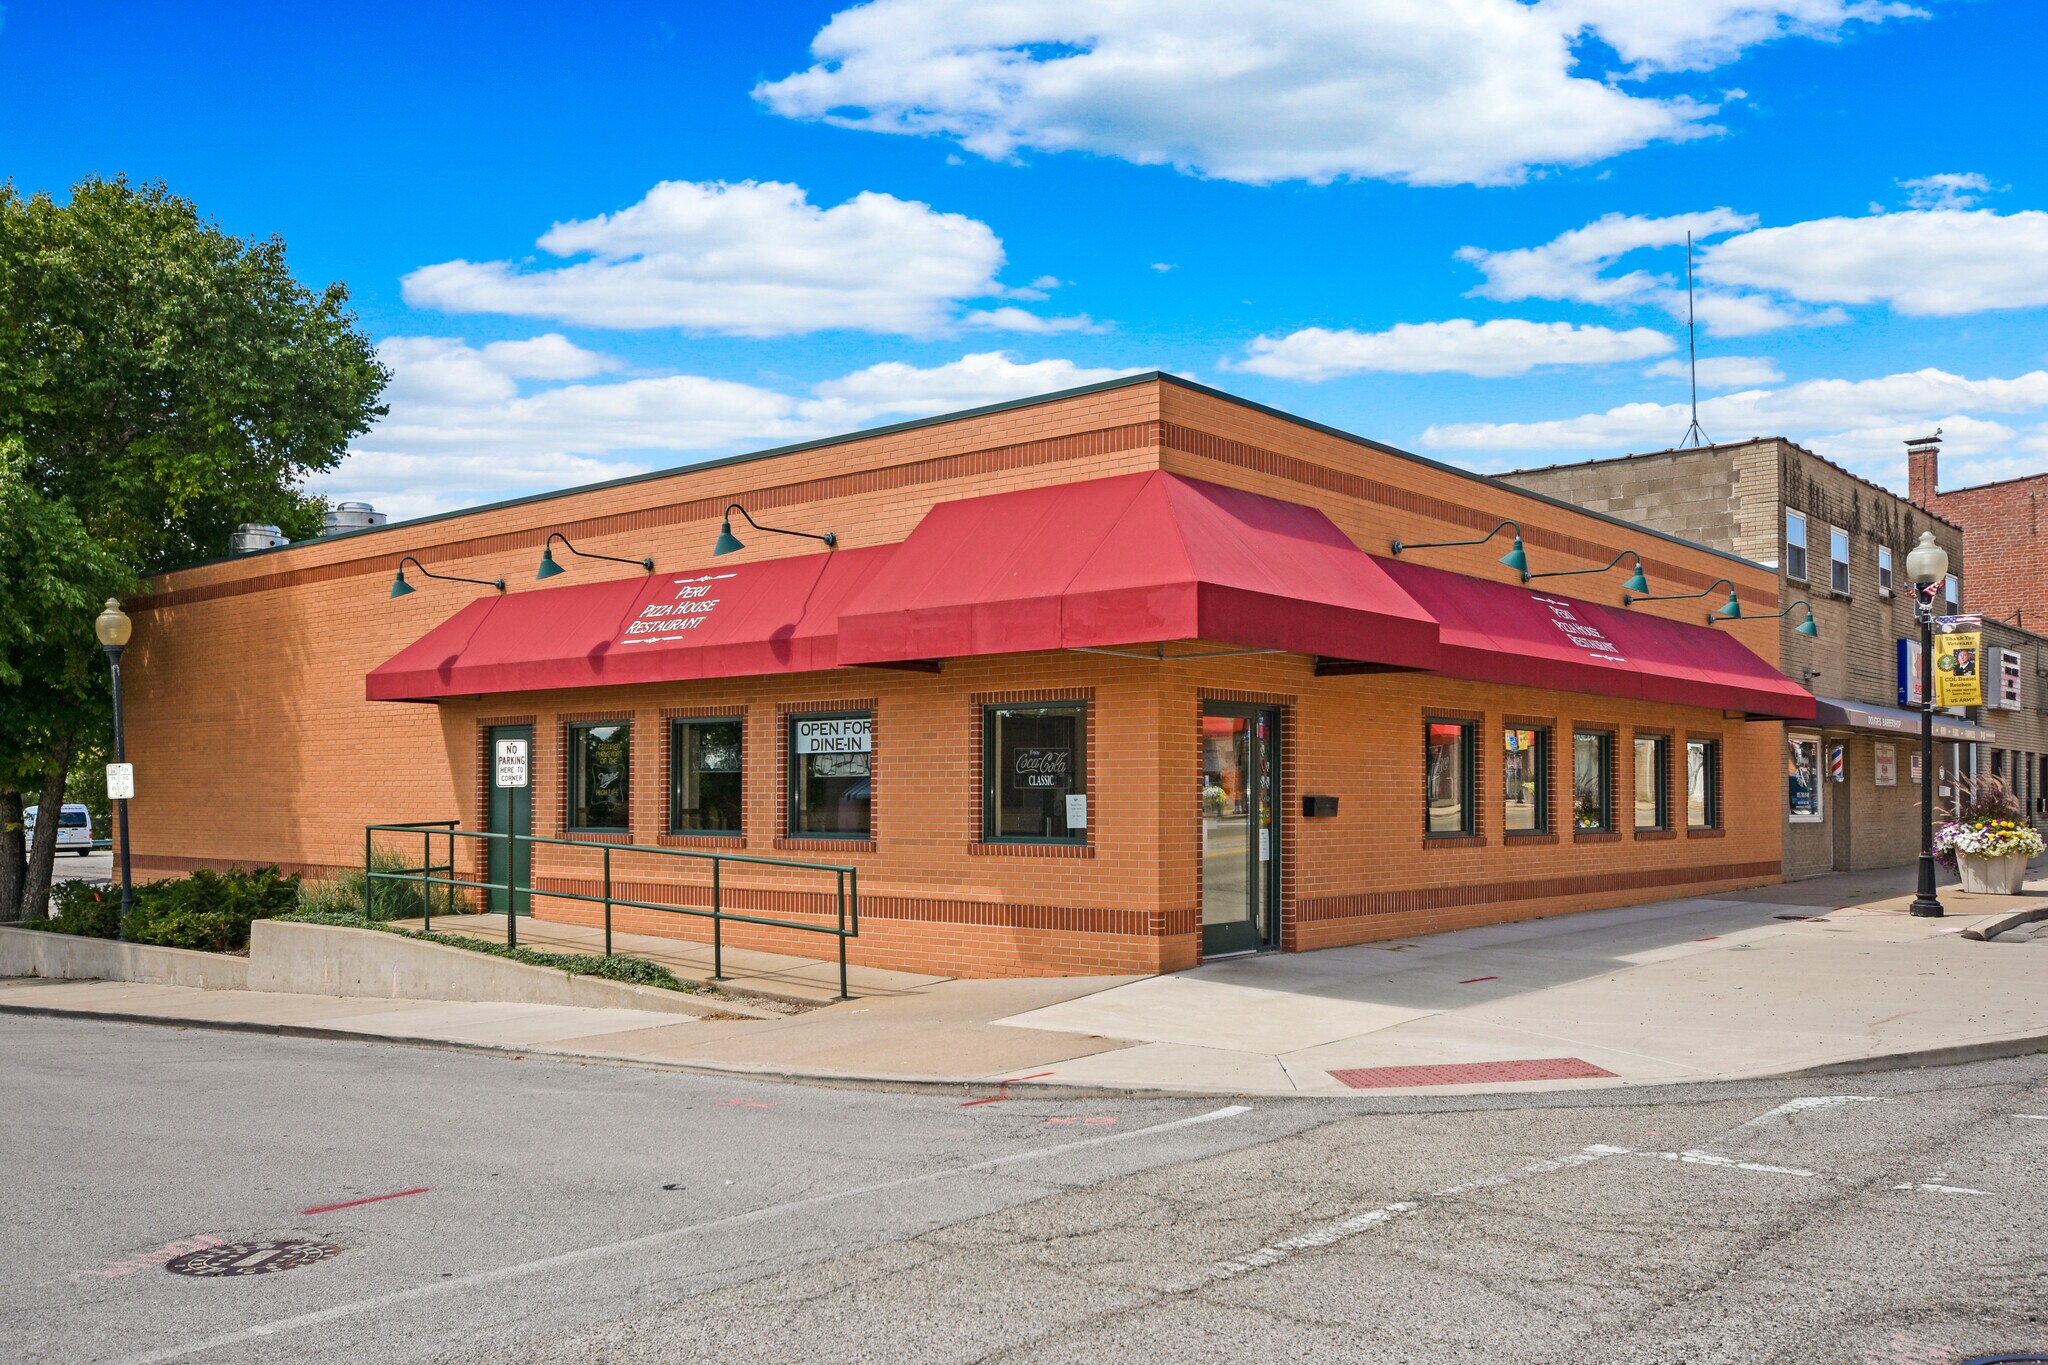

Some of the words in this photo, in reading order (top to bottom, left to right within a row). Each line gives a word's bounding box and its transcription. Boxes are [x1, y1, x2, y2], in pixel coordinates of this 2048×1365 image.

[675, 585, 711, 599] PERU
[639, 604, 673, 617] PIZZA
[672, 600, 720, 615] HOUSE
[625, 616, 706, 634] RESTAURANT
[801, 722, 839, 736] OPEN
[843, 721, 871, 735] FOR
[506, 745, 517, 754] NO
[811, 737, 862, 751] DINE-IN
[499, 756, 525, 765] PARKING
[1015, 752, 1068, 774] Coca-Cola
[1028, 775, 1055, 786] CLASSIC
